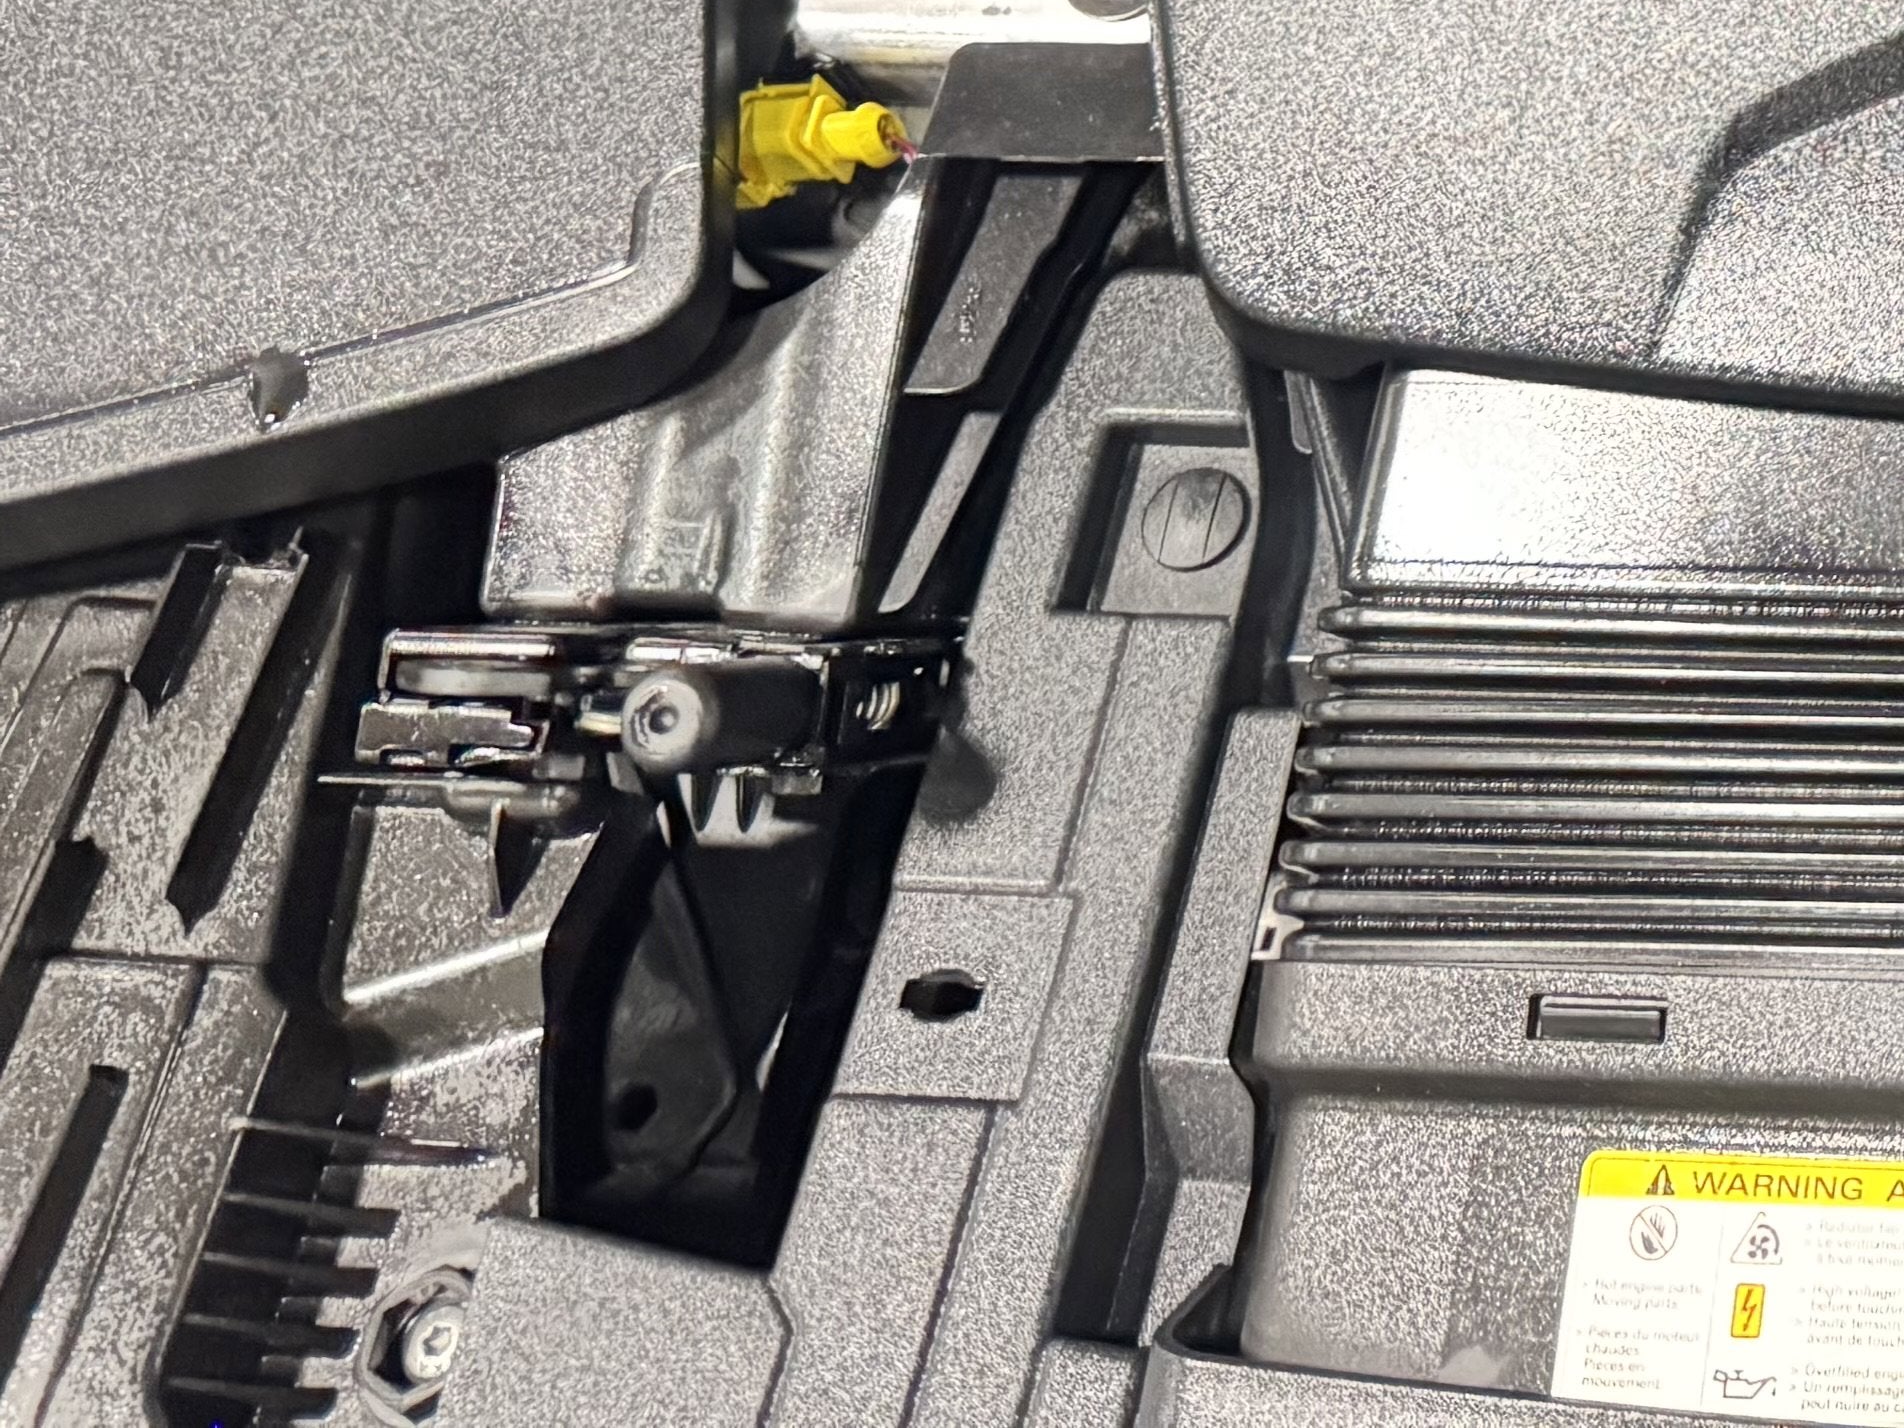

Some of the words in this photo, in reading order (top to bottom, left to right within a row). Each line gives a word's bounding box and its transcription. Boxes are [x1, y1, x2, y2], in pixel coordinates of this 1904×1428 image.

[1692, 1171, 1864, 1201] WARNING
[1803, 1380, 1823, 1393] Un
[1873, 1402, 1891, 1413] au
